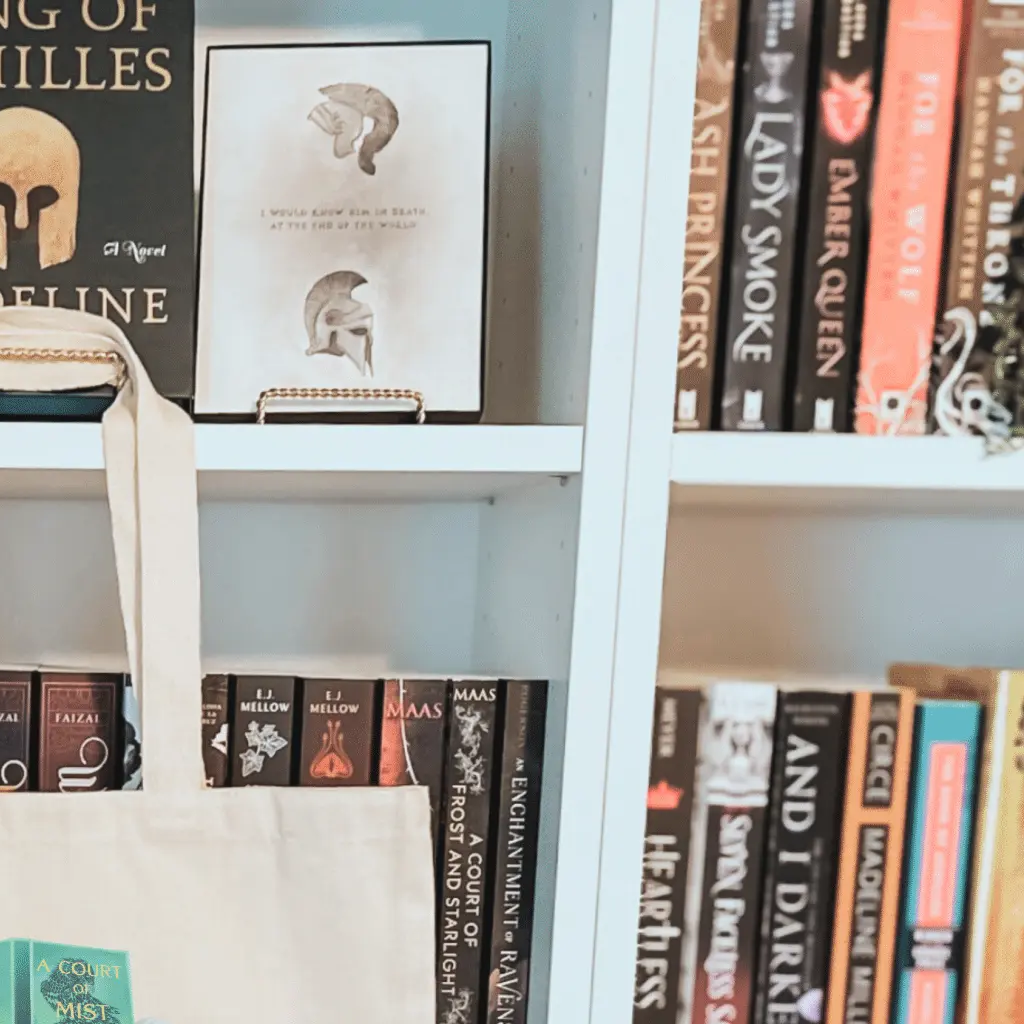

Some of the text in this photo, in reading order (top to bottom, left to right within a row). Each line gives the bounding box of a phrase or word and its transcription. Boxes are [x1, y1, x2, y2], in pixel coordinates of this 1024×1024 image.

[81, 0, 156, 31] OF
[103, 239, 167, 264] A Novel
[679, 97, 729, 371] ASH PRINCESS
[733, 111, 794, 364] LADY SMOKE
[813, 158, 860, 378] EMBER QUEEN
[897, 204, 928, 305] WOLF
[240, 702, 290, 713] MELLOW
[309, 704, 359, 714] MELLOW
[386, 703, 443, 719] MAAS
[453, 688, 497, 702] MAAS
[780, 734, 820, 832] AND
[865, 724, 894, 802] CIRCE
[441, 784, 466, 996] FROST AND STARLIGHT
[463, 834, 484, 948] A COURT OF
[504, 777, 527, 930] ENCHANTMENT
[778, 851, 811, 863] I
[850, 826, 887, 958] MADELINE
[36, 959, 121, 980] A COURT
[56, 1001, 109, 1021] MIST
